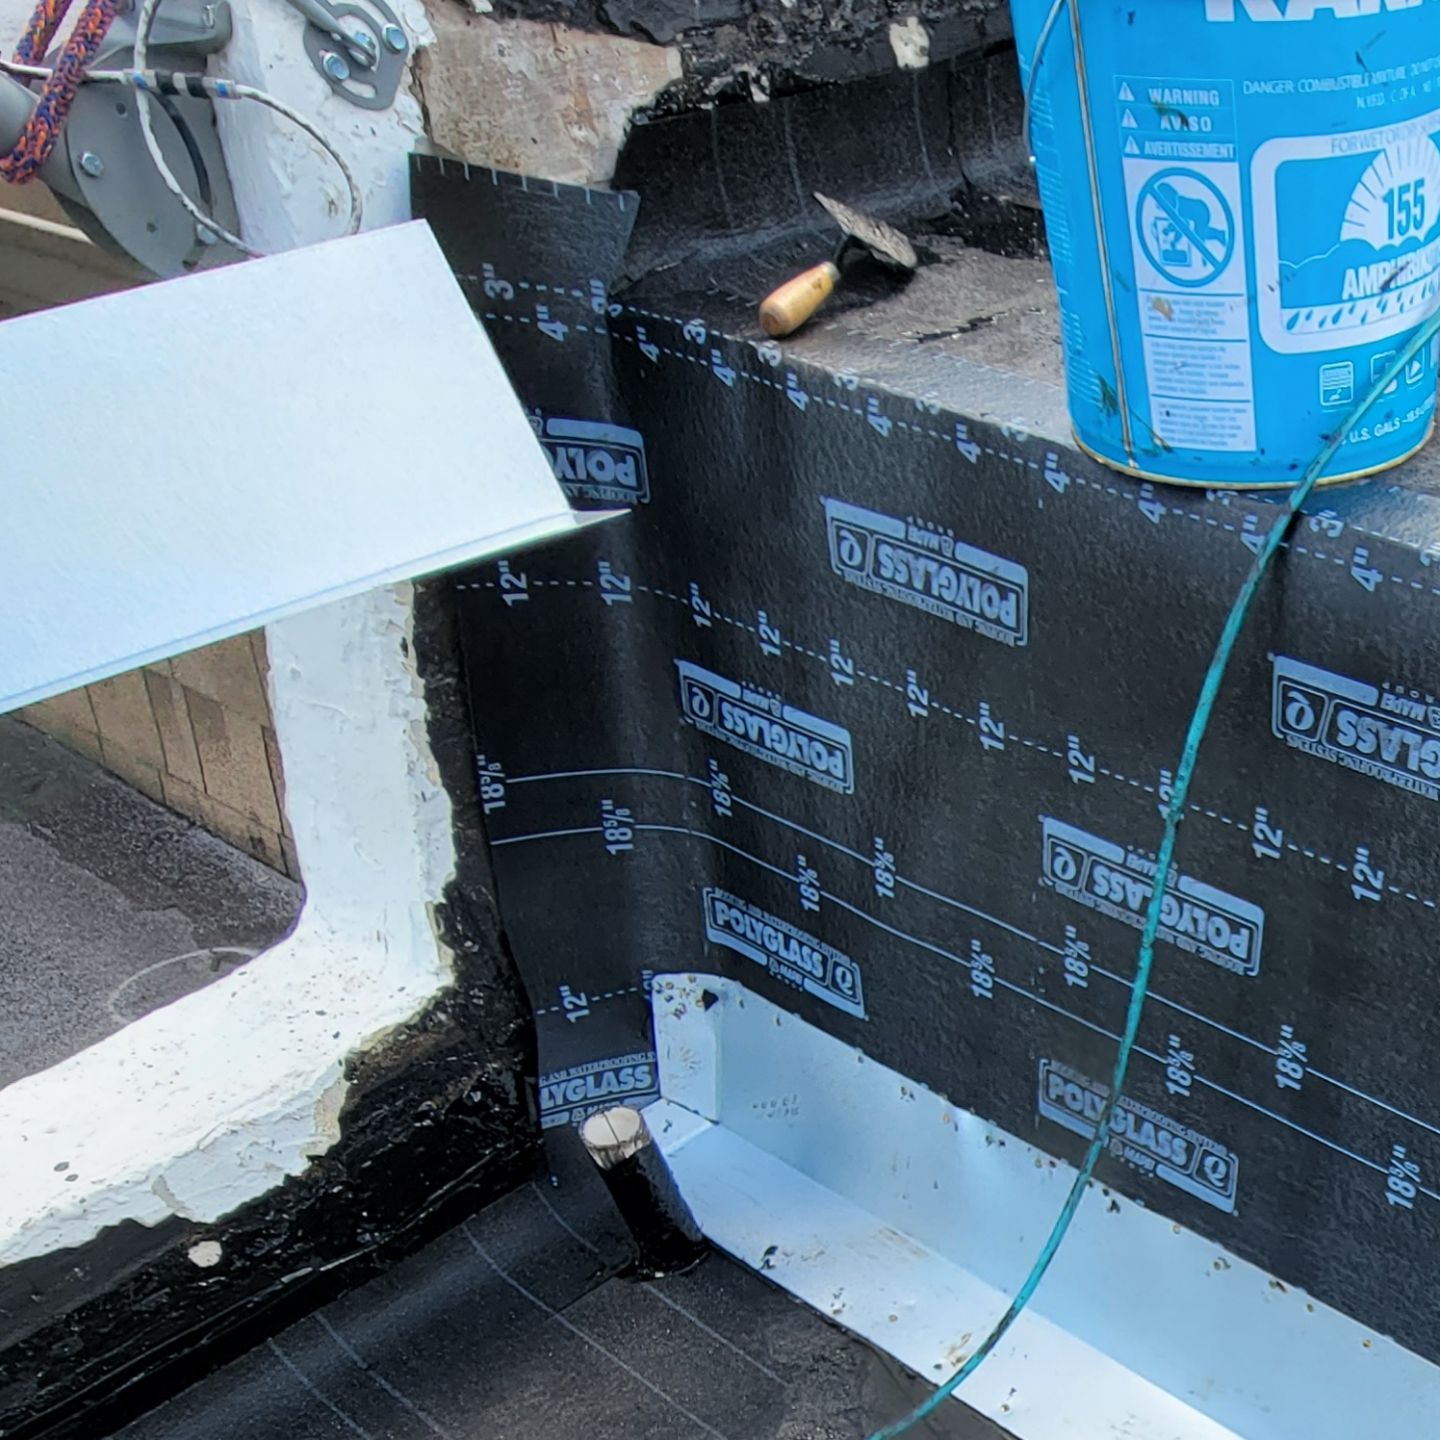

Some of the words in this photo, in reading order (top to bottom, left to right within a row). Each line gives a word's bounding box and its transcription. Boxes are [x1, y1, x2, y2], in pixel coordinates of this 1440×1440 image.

[1148, 87, 1221, 107] WARNING
[1382, 176, 1426, 241] 155
[483, 263, 514, 300] 3"
[537, 304, 569, 342] 4"
[711, 348, 736, 387] 4"
[786, 372, 809, 411] 4"
[868, 397, 892, 438] 4"
[956, 423, 981, 464] 4"
[1044, 452, 1070, 494] 4"
[1138, 483, 1167, 525] 4"
[1309, 508, 1344, 538] 3"
[499, 560, 529, 606] 12"
[600, 560, 633, 606] 12"
[877, 543, 1018, 629] POLYGLASS
[1351, 546, 1384, 592] 4"
[689, 582, 712, 627] 12"
[757, 610, 781, 656] 12"
[830, 639, 854, 686] 12"
[907, 669, 930, 718] 12"
[721, 701, 845, 780] POLYGLASS
[979, 702, 1005, 751] 12"
[1066, 734, 1096, 785] 12"
[1252, 806, 1283, 860] 12"
[1351, 846, 1386, 902] 12"
[714, 899, 825, 979] POLYGLASS
[559, 984, 590, 1023] 12"
